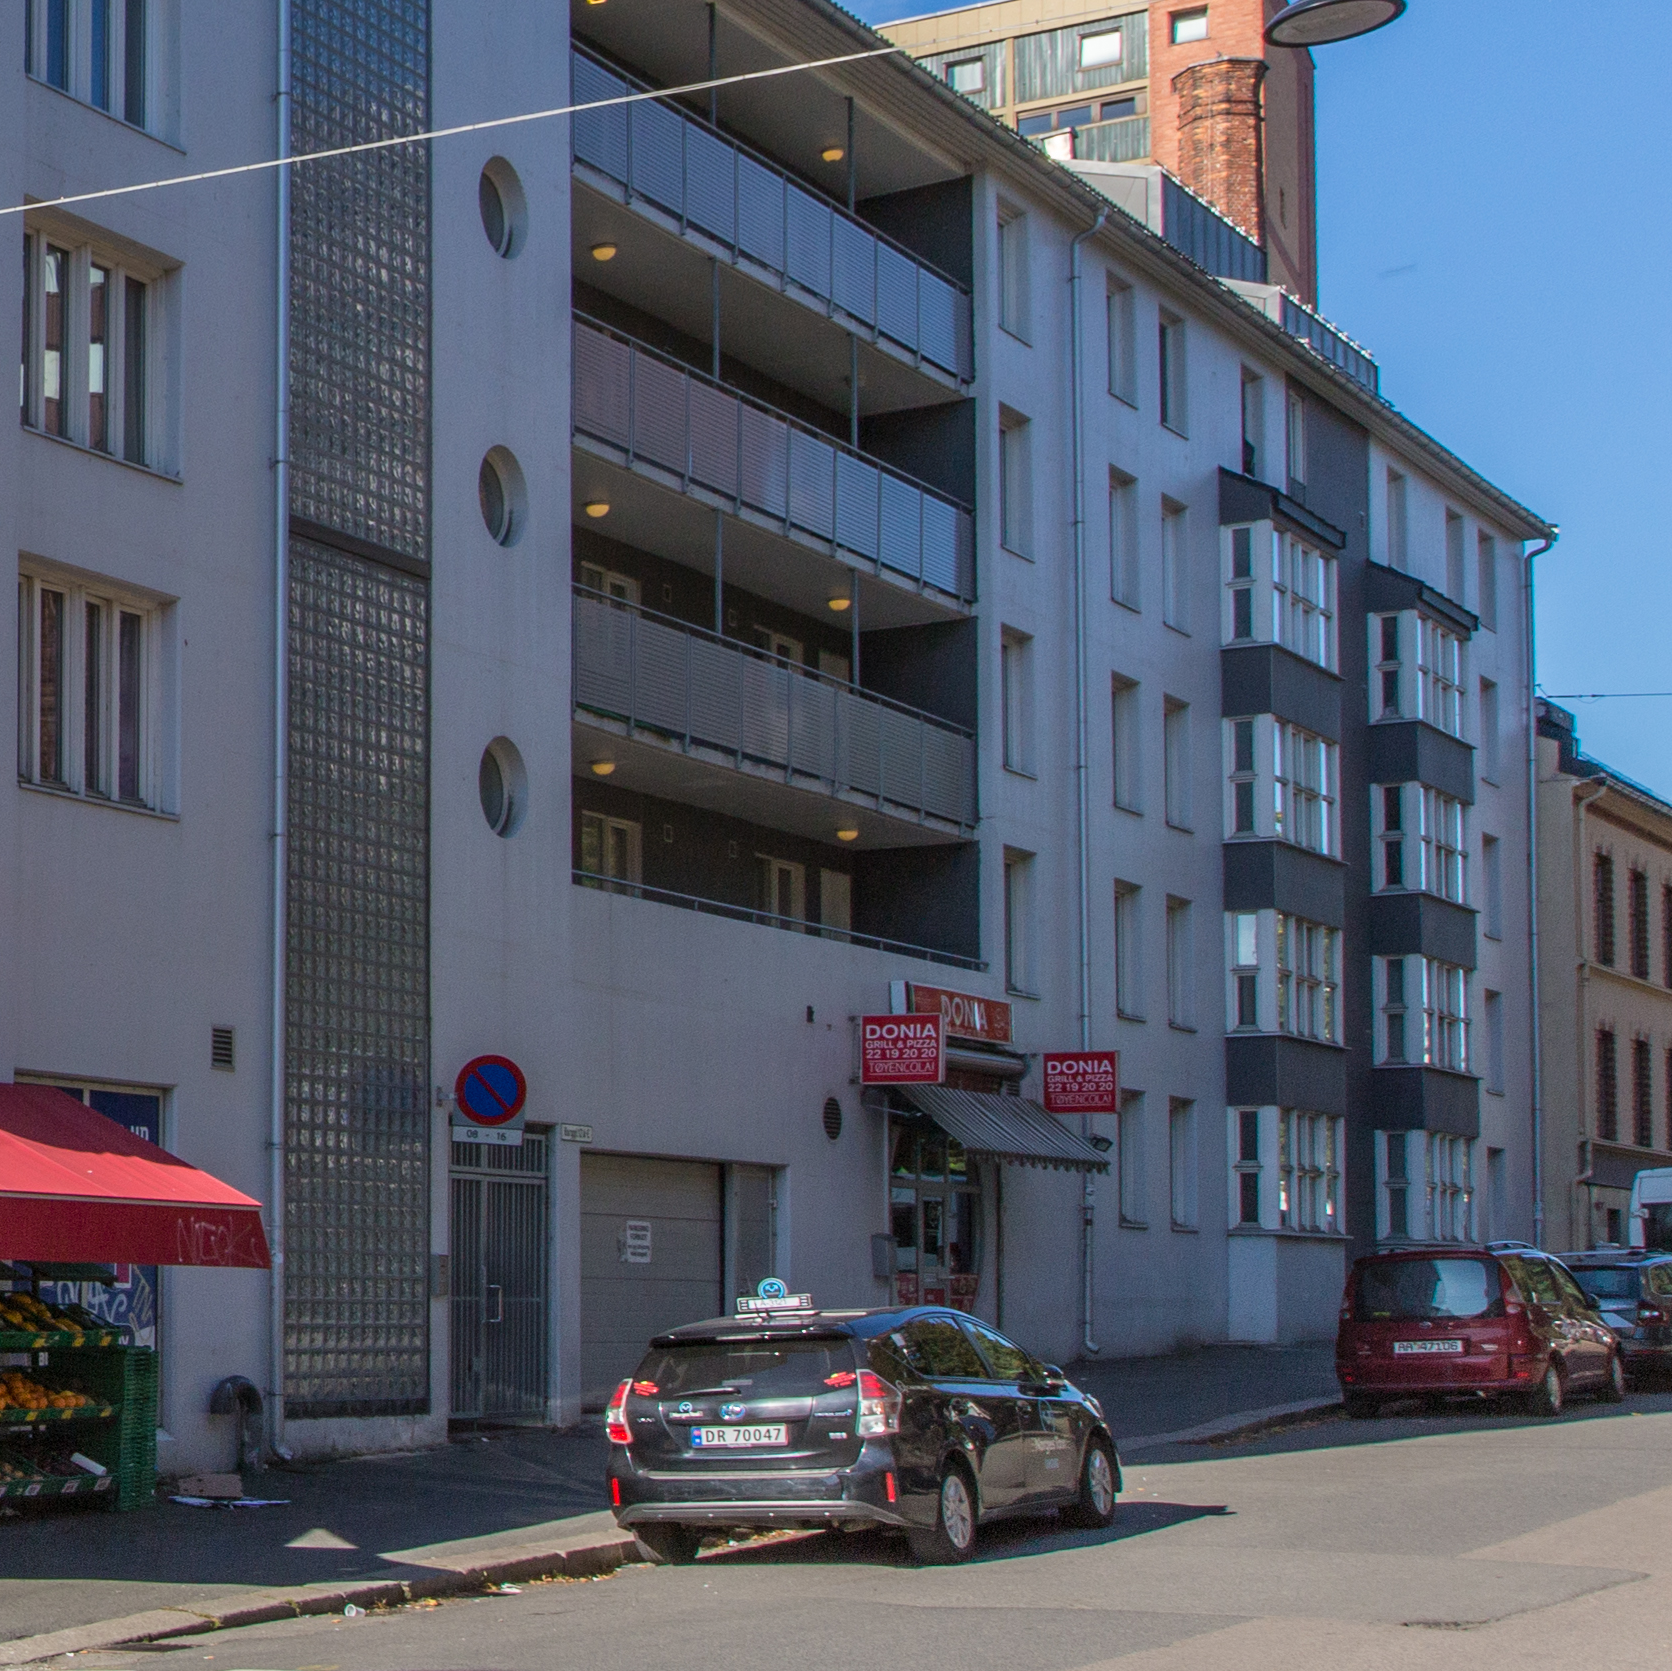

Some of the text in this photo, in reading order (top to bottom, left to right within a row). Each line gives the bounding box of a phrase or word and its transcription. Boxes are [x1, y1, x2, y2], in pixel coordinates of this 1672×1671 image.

[940, 994, 988, 1030] DONIA
[865, 1023, 937, 1039] DONIA
[865, 1039, 937, 1049] GRILL & PIZZA
[865, 1048, 937, 1059] 22 19 20 20
[1046, 1059, 1113, 1074] DONIA
[1047, 1075, 1074, 1083] GRILL
[1085, 1074, 1113, 1082] PIZZA
[1047, 1082, 1113, 1092] 22 19 20 20
[466, 1129, 478, 1139] 08
[496, 1131, 507, 1141] 16
[1397, 1342, 1414, 1352] AA
[705, 1428, 782, 1443] DR 70047
